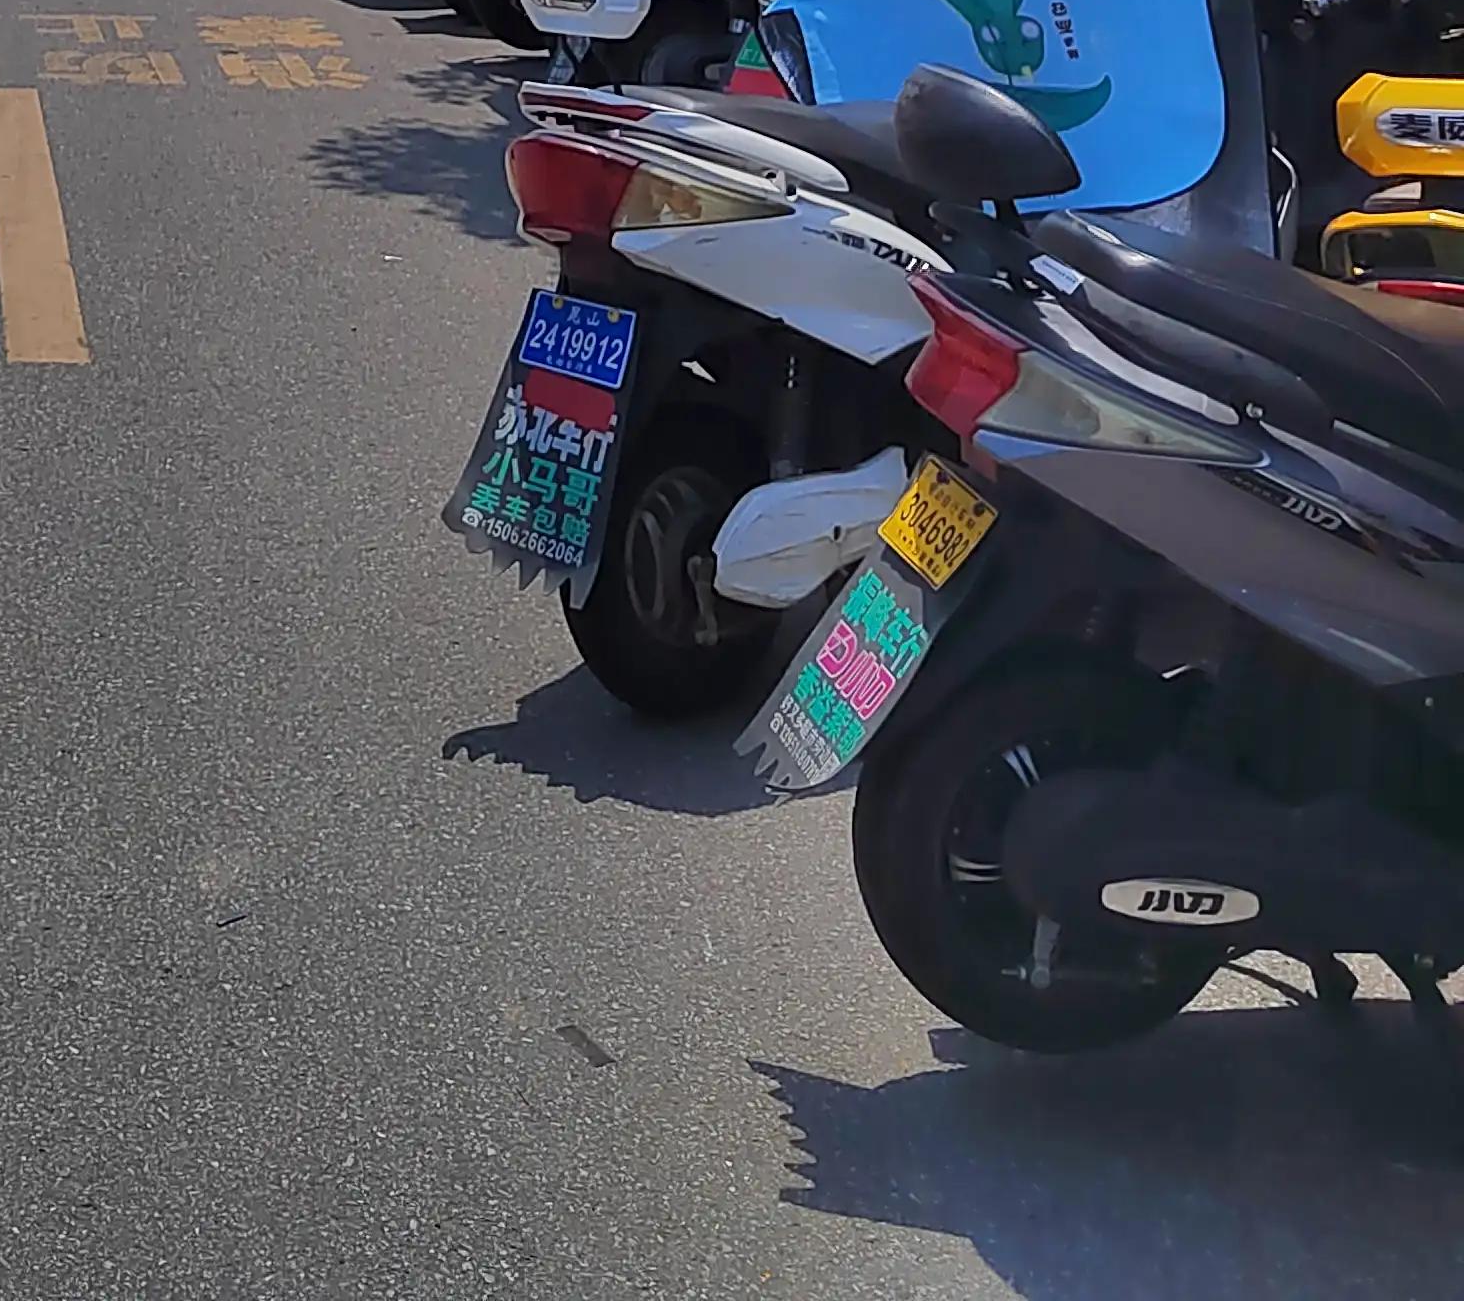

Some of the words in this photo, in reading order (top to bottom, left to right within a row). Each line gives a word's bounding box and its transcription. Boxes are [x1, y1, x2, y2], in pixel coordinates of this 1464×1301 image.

[529, 319, 624, 370] 2419912
[567, 305, 601, 326] 昆山
[494, 384, 618, 473] 苏北车行
[482, 447, 602, 516] 小马哥
[471, 482, 591, 547] 丢车包赔
[487, 518, 584, 568] 15062662064
[900, 492, 970, 568] 3046982
